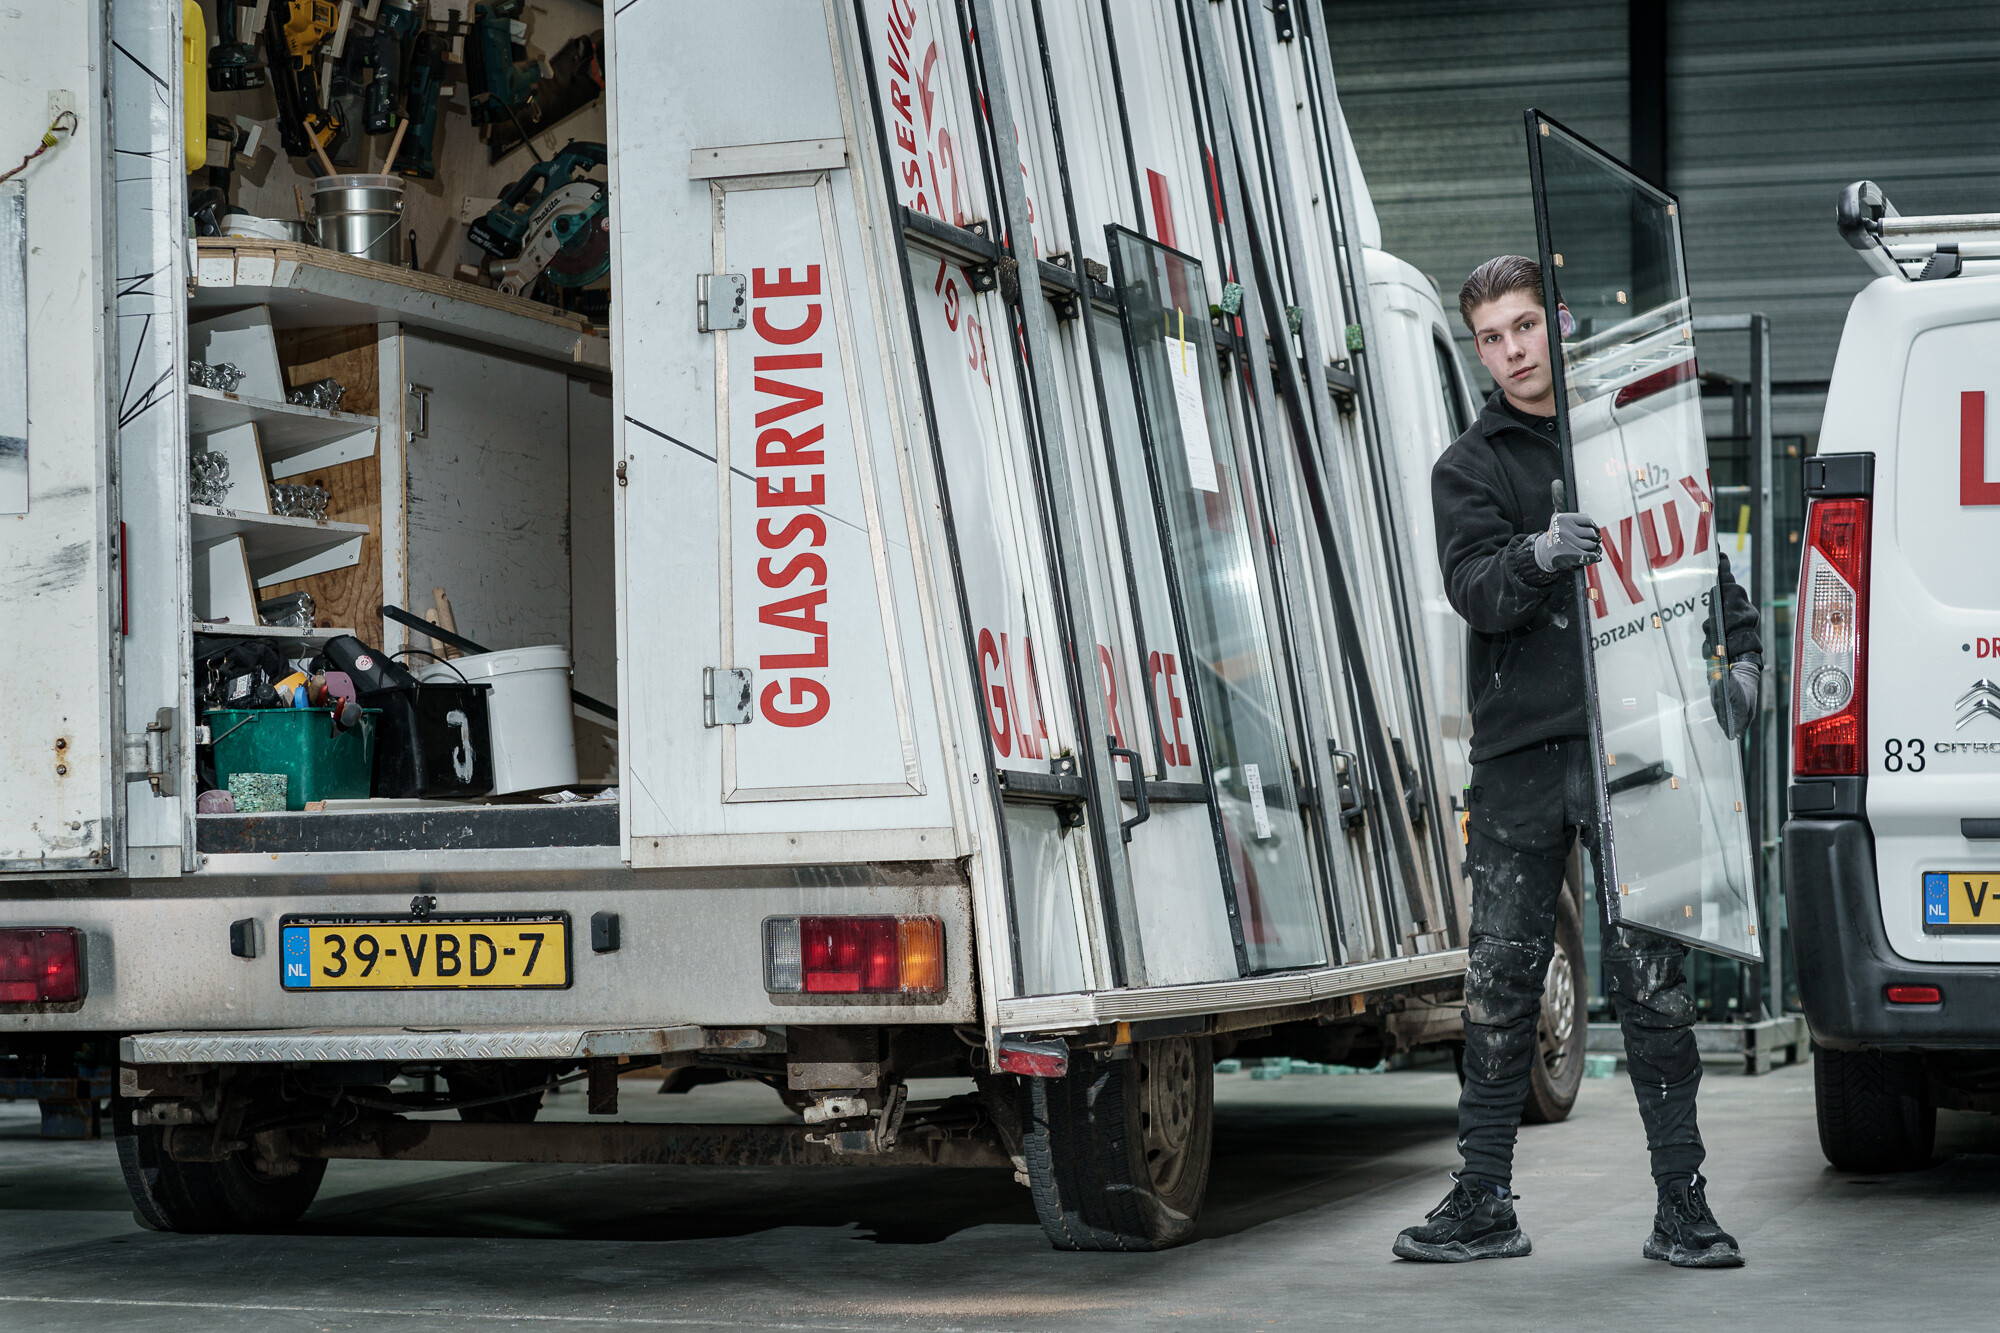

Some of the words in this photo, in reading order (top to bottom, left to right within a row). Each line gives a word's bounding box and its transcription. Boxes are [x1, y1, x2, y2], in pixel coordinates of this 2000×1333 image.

[752, 264, 831, 728] GLASSERVICE
[1884, 738, 1926, 772] 83
[1928, 904, 1946, 916] NL
[288, 965, 307, 977] NL
[322, 933, 545, 978] 39-VBD-7
